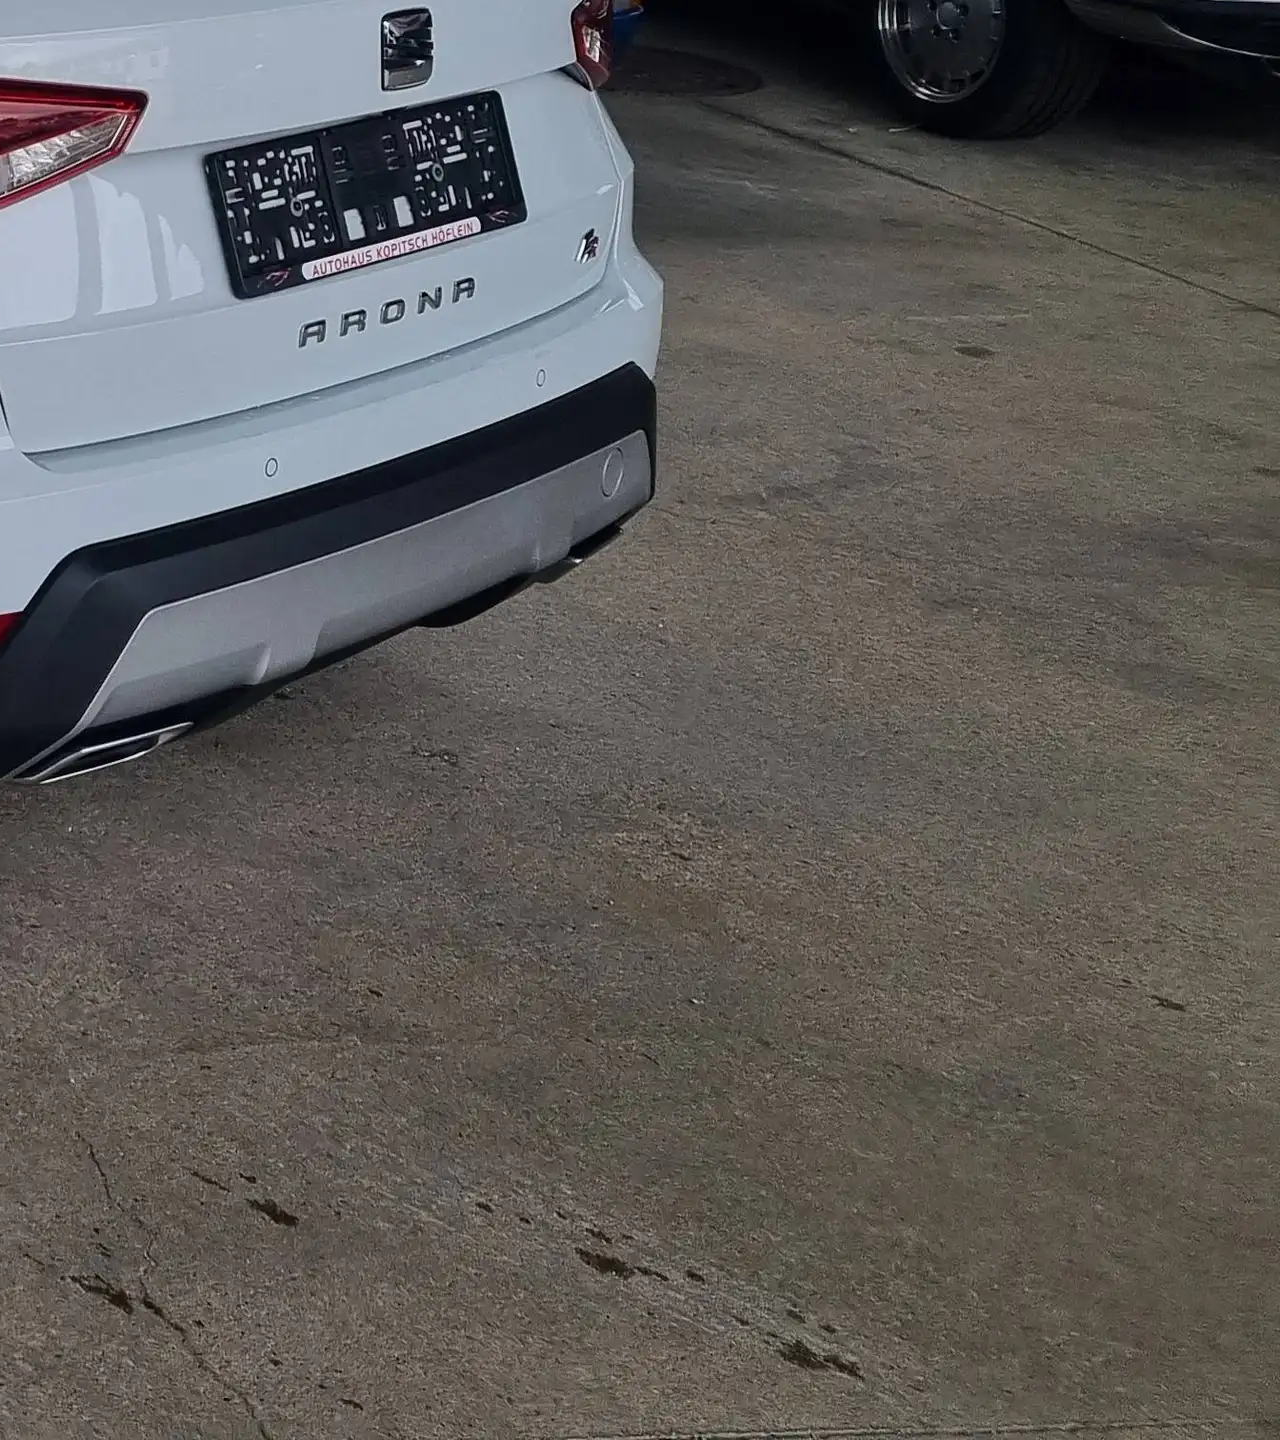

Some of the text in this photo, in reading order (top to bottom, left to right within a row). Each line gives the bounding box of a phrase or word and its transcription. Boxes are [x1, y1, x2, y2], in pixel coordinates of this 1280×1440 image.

[311, 221, 474, 278] AUTOHAUS KOPITSCH HÖFLEIN
[298, 277, 476, 348] ARONA
